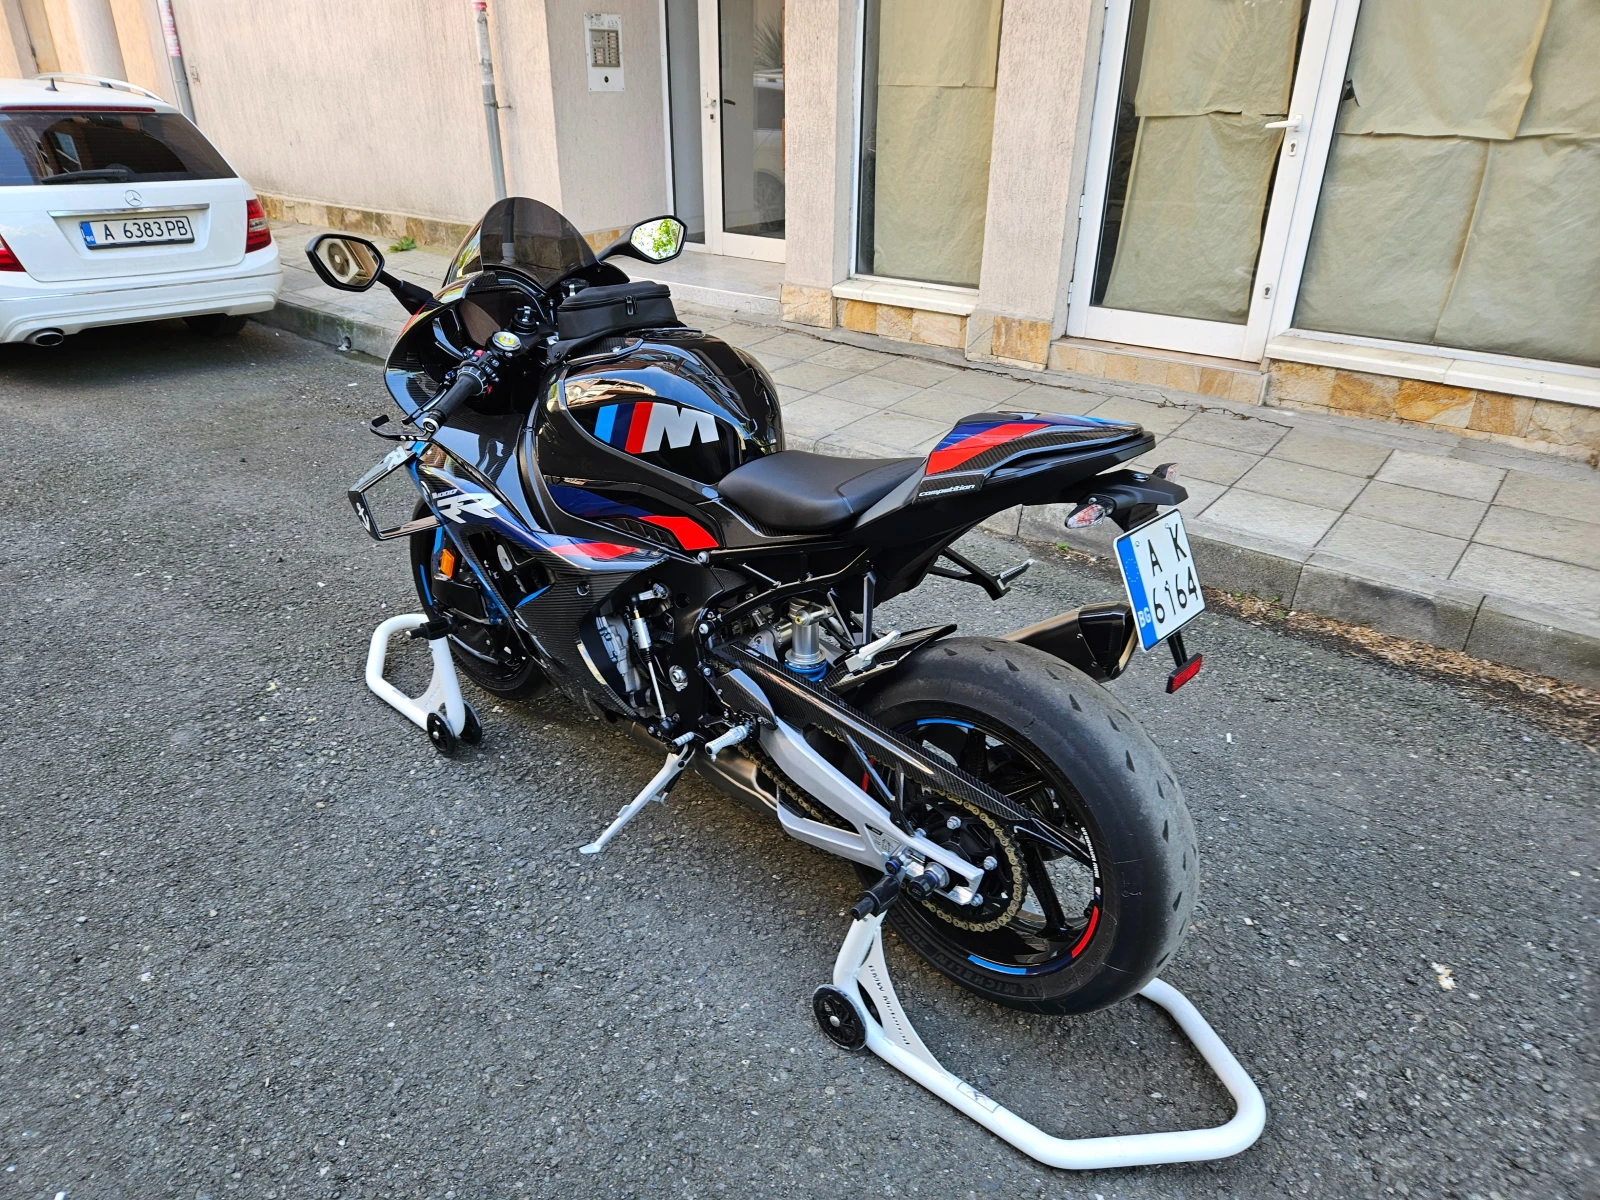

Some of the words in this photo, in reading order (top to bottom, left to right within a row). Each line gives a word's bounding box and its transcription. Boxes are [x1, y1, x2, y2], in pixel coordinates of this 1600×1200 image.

[104, 224, 115, 240] A
[641, 402, 719, 452] M
[1147, 539, 1163, 577] A
[1168, 523, 1187, 562] K
[1137, 607, 1152, 628] BG
[1153, 566, 1199, 624] 6164
[935, 953, 1018, 994] MICHELIN
